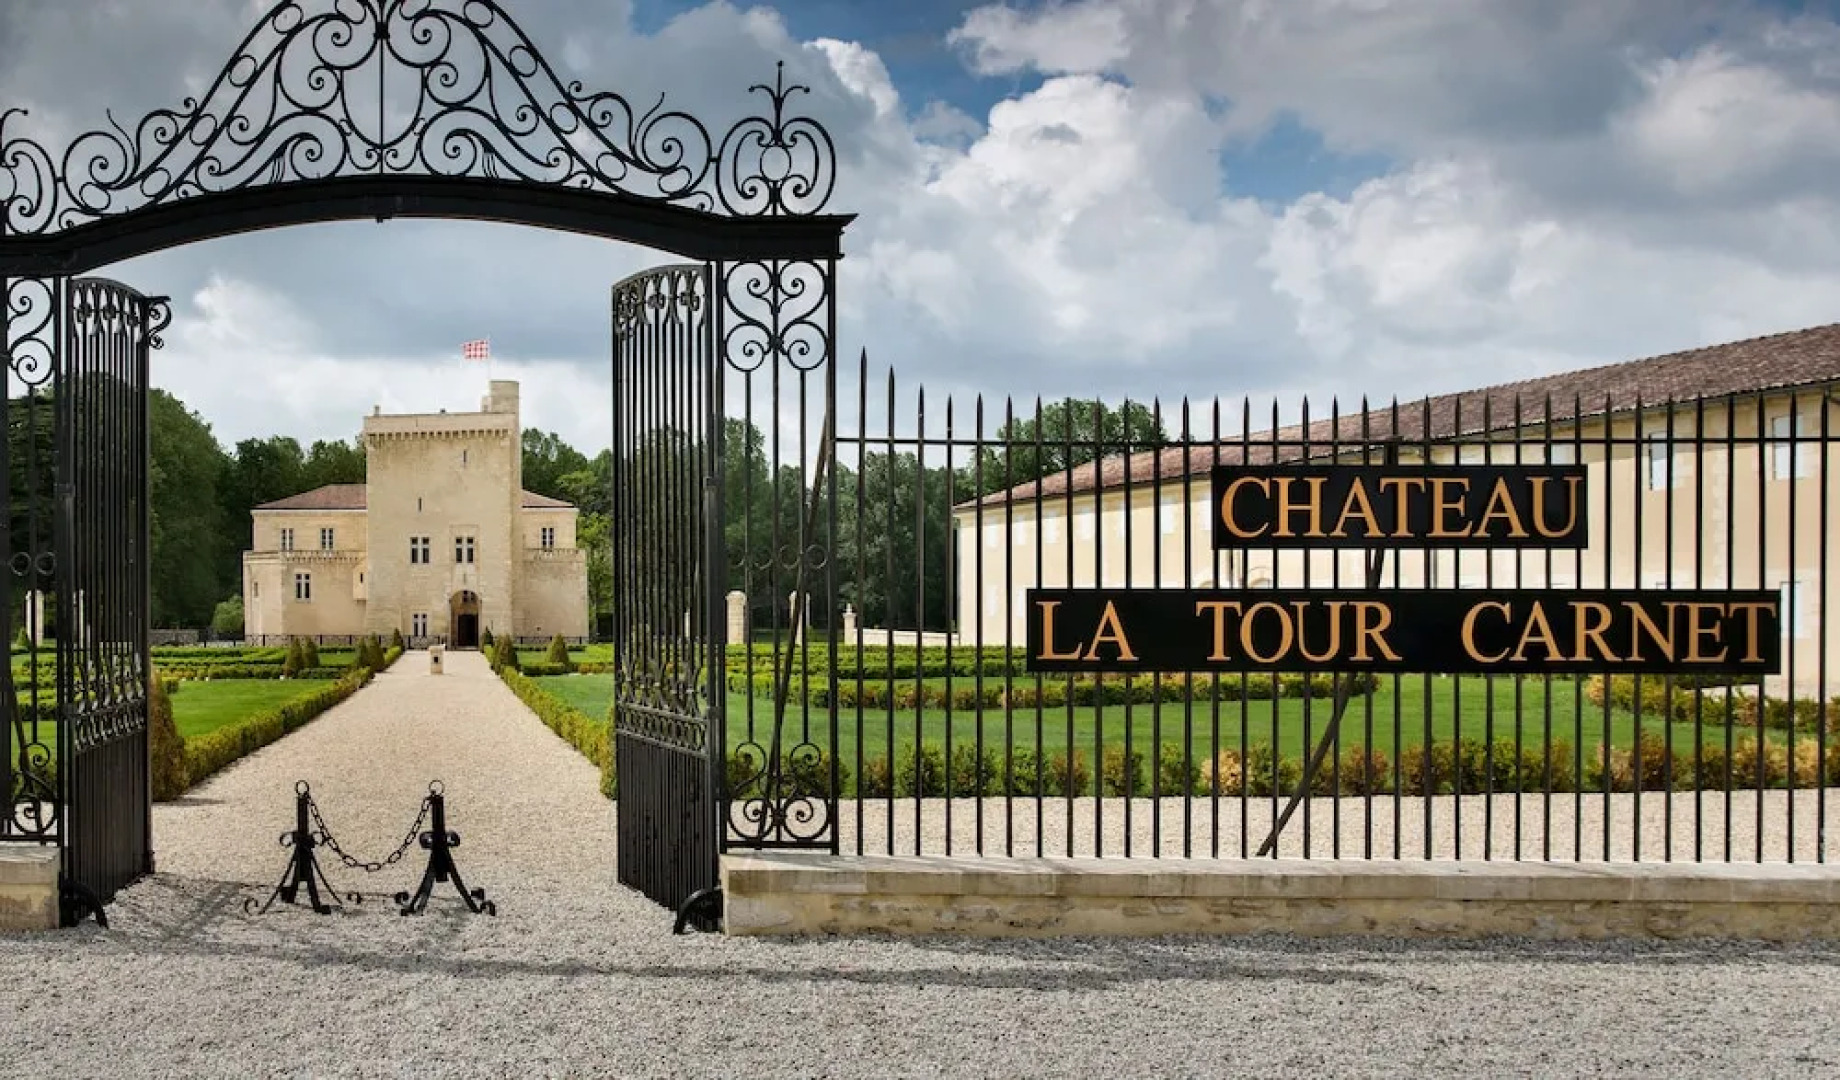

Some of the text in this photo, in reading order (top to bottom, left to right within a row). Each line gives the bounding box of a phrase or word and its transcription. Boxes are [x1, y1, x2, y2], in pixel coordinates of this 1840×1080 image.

[1221, 476, 1583, 538] CHATEAU
[1036, 600, 1777, 664] LA TOUR CARNET
